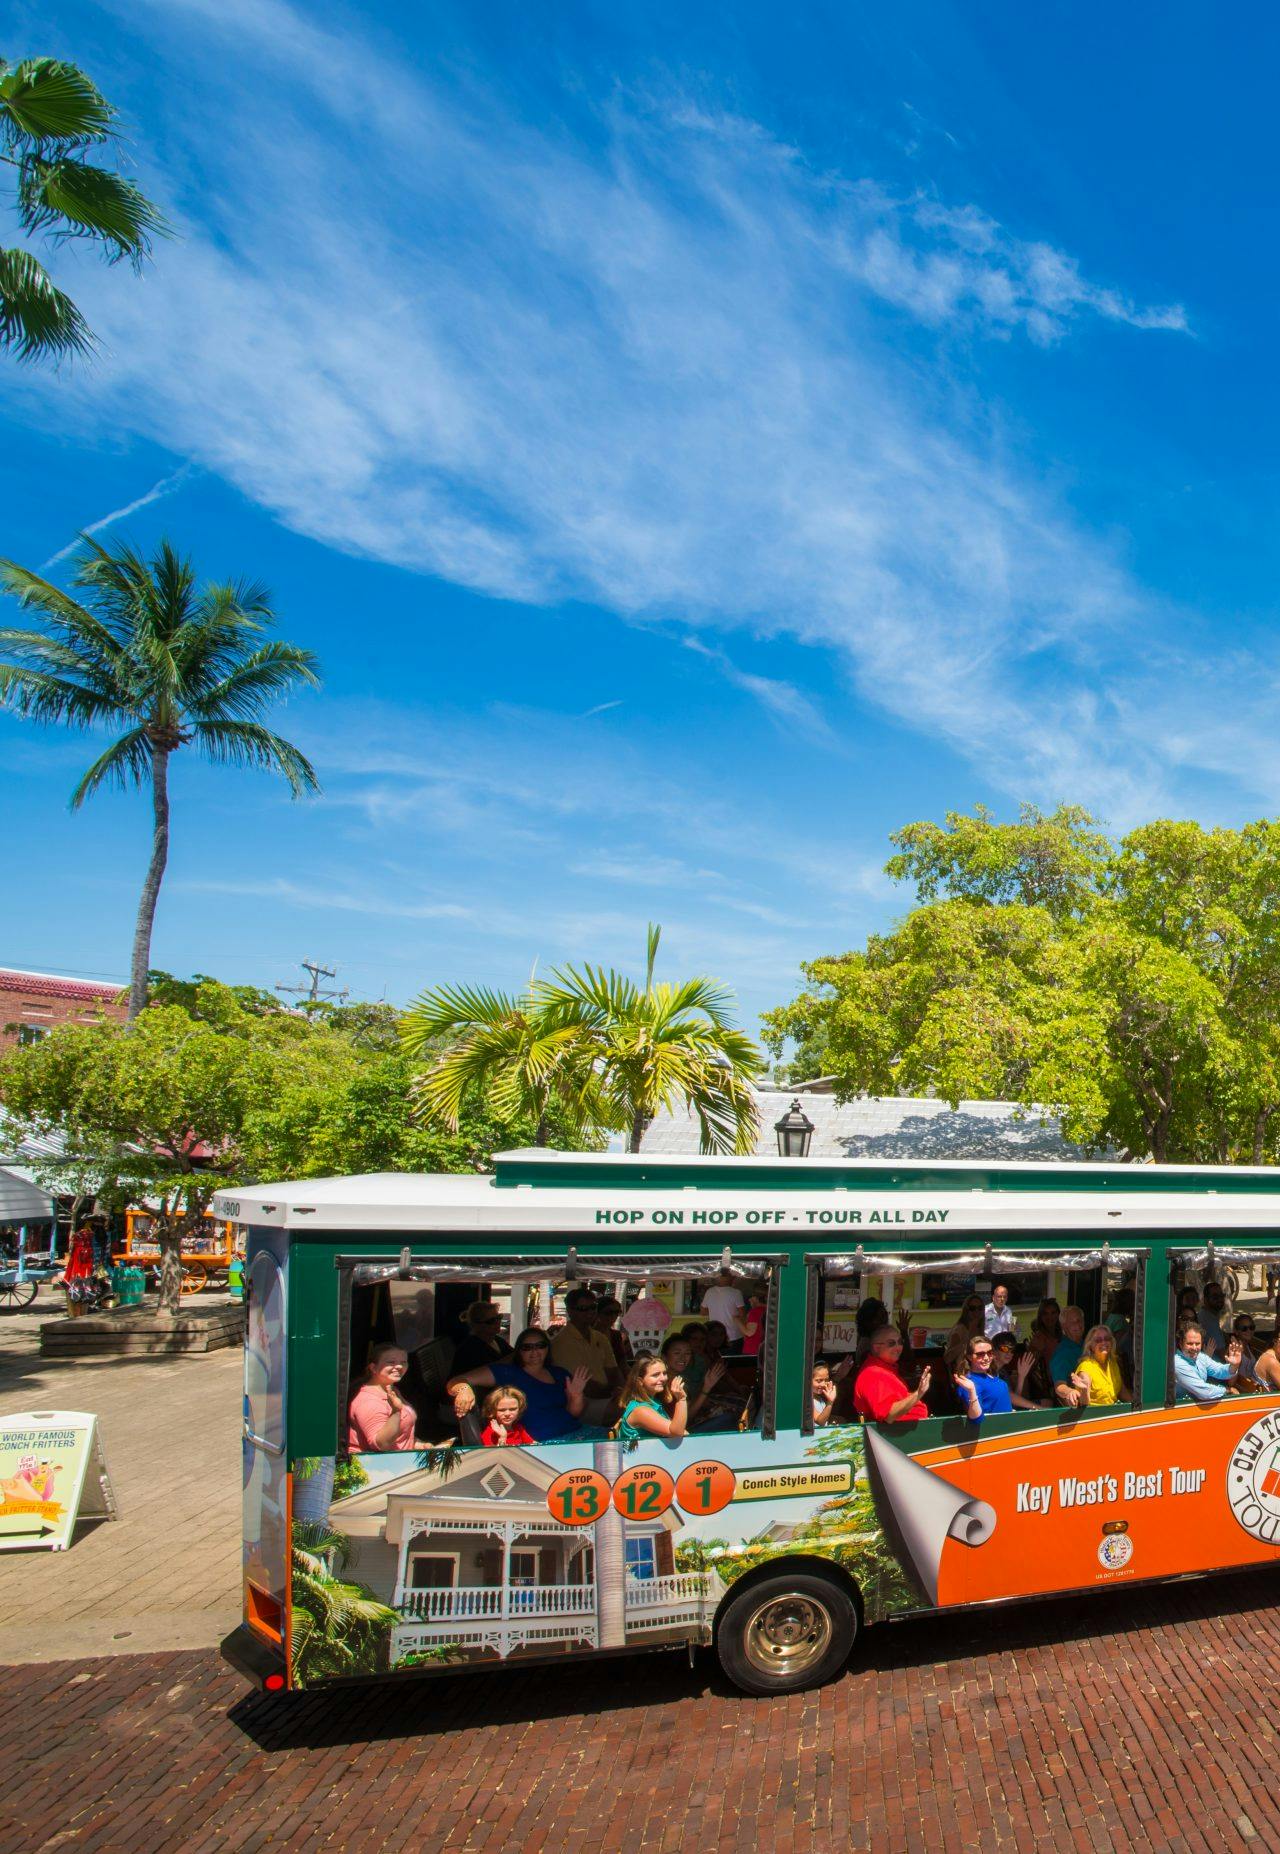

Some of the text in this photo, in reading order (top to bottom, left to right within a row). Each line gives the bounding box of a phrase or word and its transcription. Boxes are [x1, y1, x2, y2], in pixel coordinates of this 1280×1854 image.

[595, 1210, 644, 1224] HOP
[651, 1210, 684, 1224] ON
[692, 1210, 738, 1224] HOP
[745, 1210, 786, 1224] OFF
[806, 1210, 862, 1224] TOUR
[869, 1210, 906, 1223] ALL
[912, 1209, 950, 1223] DAY
[2, 1430, 75, 1442] WORLD FAMOUS
[0, 1439, 75, 1451] CONCH FRITTERS
[1233, 1432, 1264, 1472] OLD
[633, 1470, 657, 1480] STOP
[695, 1466, 718, 1476] STOP
[568, 1475, 593, 1485] STOP
[742, 1472, 846, 1491] Conch Style Homes
[620, 1481, 662, 1514] 12
[696, 1477, 712, 1508] 1
[1016, 1467, 1206, 1515] Key West's Best Tour
[556, 1486, 599, 1519] 13
